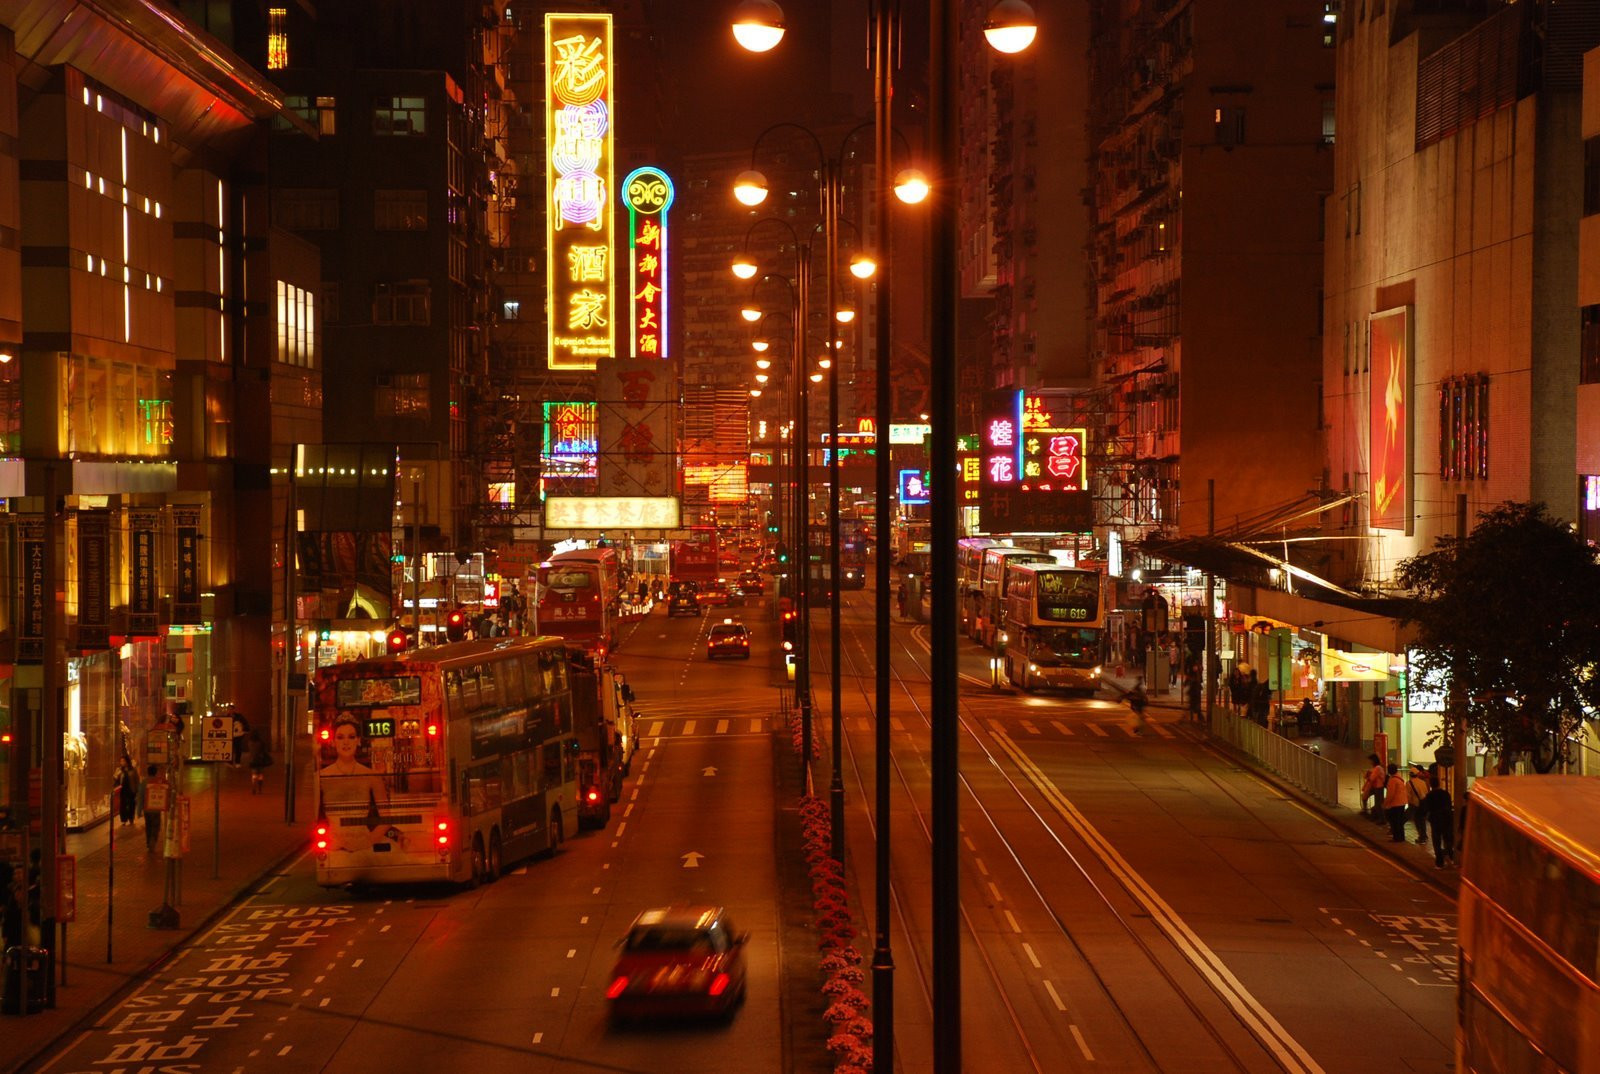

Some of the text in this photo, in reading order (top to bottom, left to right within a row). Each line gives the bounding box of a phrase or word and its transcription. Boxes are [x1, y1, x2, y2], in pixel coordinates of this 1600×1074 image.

[1070, 608, 1087, 619] 619
[368, 722, 391, 736] 116
[221, 752, 230, 760] 12
[247, 905, 354, 920] BUS
[217, 917, 356, 932] STOP
[205, 931, 328, 952] 巴士
[198, 951, 292, 973] 站
[163, 972, 290, 990] BUS
[123, 987, 293, 1008] STOP
[107, 1006, 254, 1035] 巴士
[91, 1035, 209, 1064] 站
